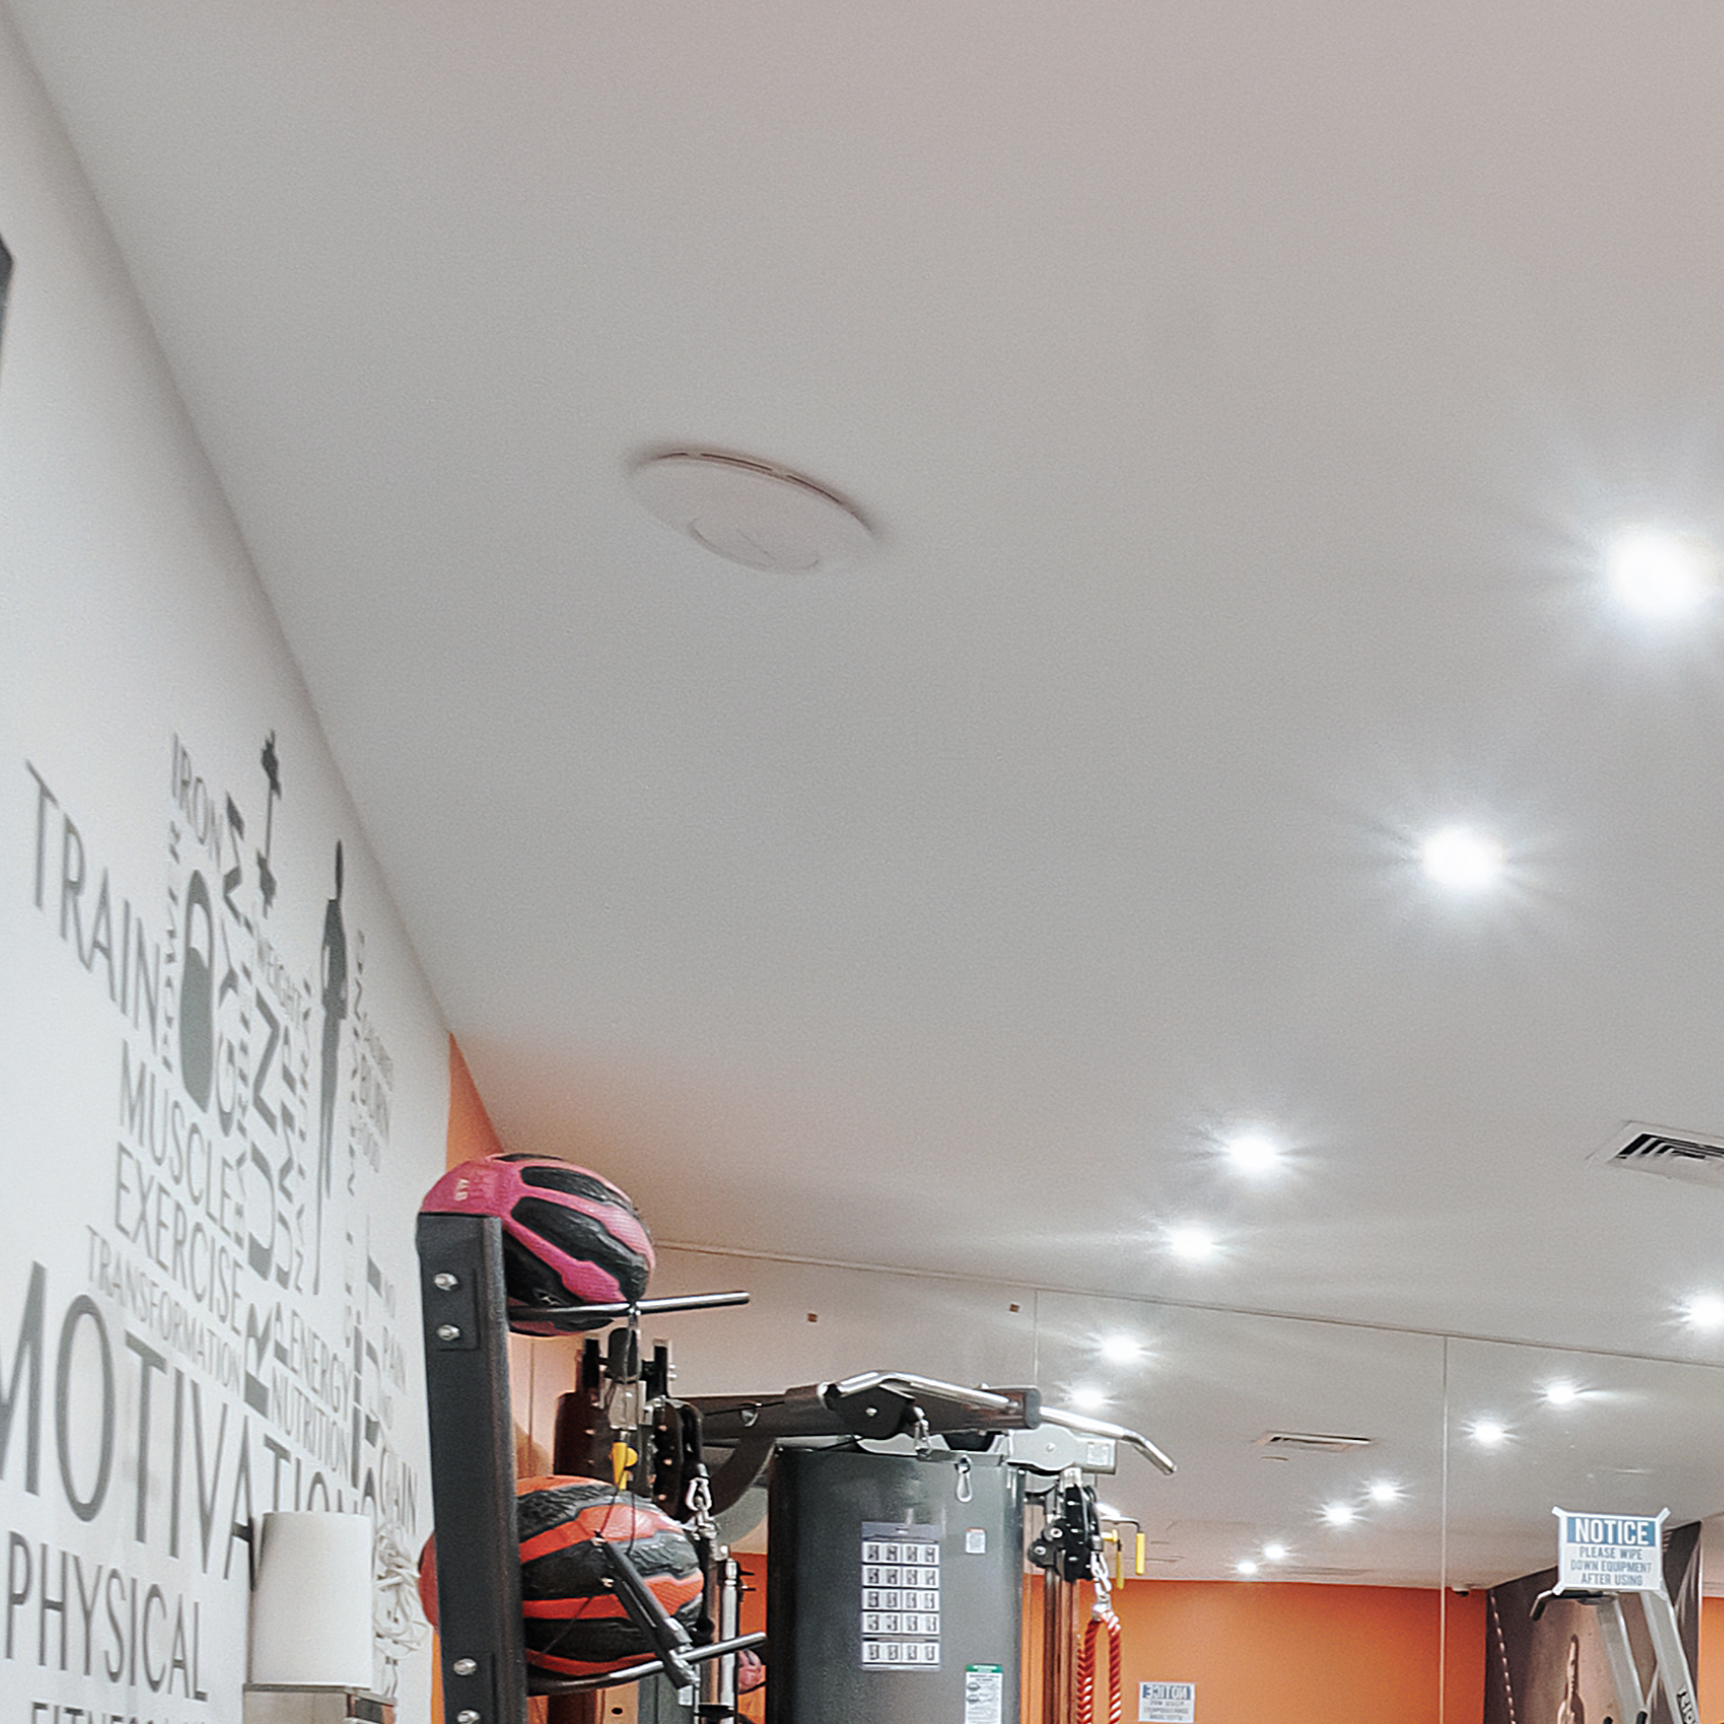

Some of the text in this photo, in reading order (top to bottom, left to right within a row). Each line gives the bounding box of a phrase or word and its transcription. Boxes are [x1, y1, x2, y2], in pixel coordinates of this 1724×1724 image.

[172, 732, 223, 873] IRON
[24, 759, 161, 1055] TRAIN
[217, 790, 245, 1137] GYM
[120, 1038, 236, 1239] MUSCLE
[245, 987, 281, 1418] RUN
[274, 1025, 297, 1367] PUMP
[87, 1224, 242, 1394] TRANSFORMATION
[115, 1139, 243, 1338] EXERCISE
[271, 1367, 350, 1482] NUTRITION
[291, 1308, 353, 1423] ENERGY
[5, 1531, 208, 1702] PHYSICAL
[1571, 1560, 1652, 1573] DOWN EQUIPMENT
[1575, 1518, 1649, 1545] NOTICE
[1579, 1547, 1643, 1560] PLEASE WIPE
[1581, 1574, 1643, 1586] AFTER USING
